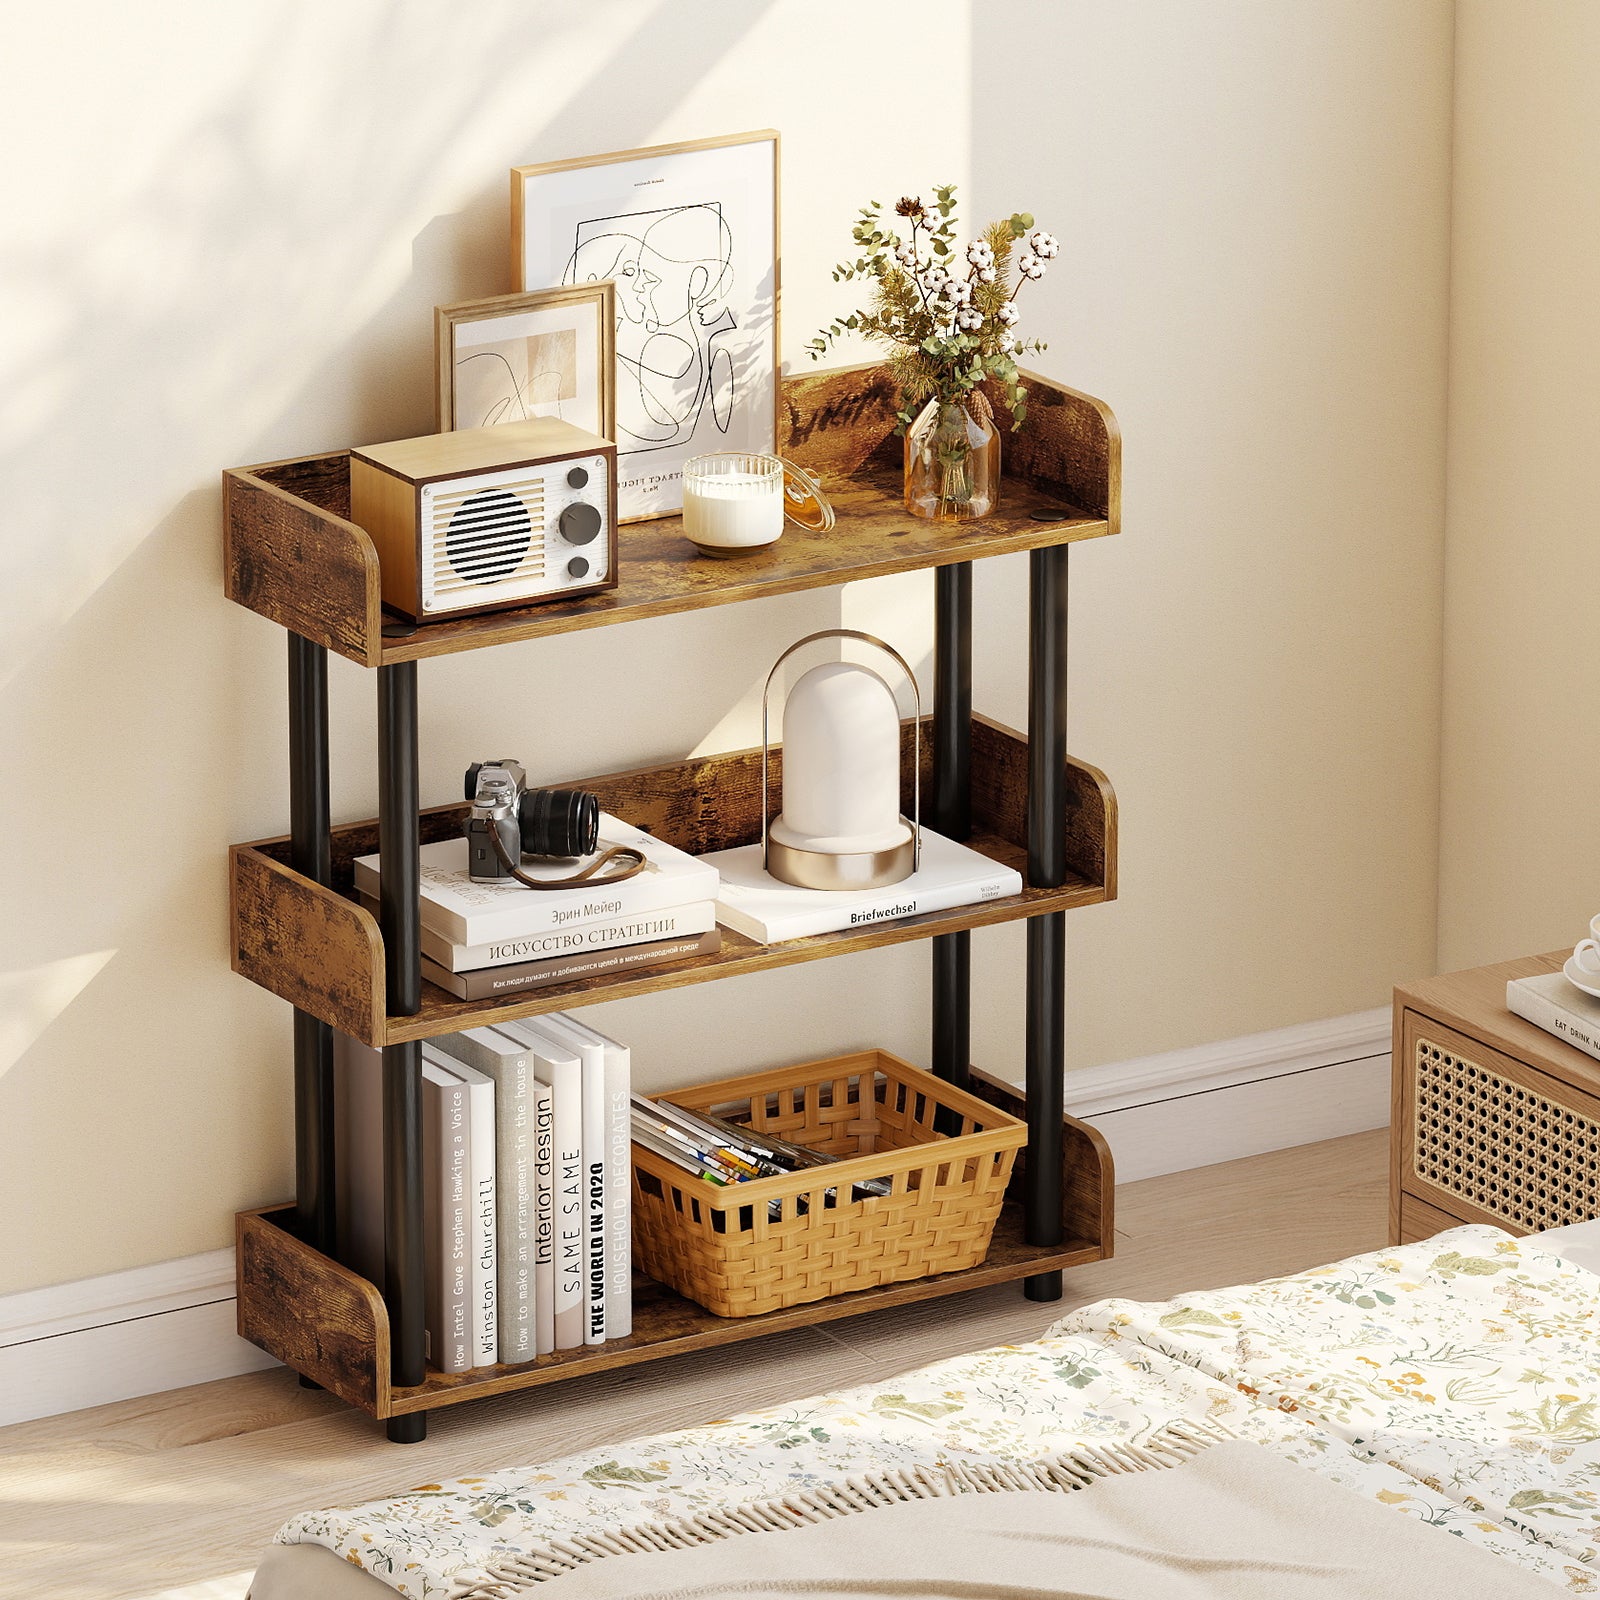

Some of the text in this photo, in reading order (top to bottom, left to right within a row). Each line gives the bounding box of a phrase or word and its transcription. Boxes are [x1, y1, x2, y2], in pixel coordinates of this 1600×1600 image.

[489, 919, 676, 960] ИСКУССТВО СТРАТЕГИИ
[493, 980, 506, 989] Как
[506, 978, 524, 986] люди
[524, 972, 550, 983] думают
[557, 963, 597, 976] добиваются
[598, 957, 619, 968] целей
[624, 946, 678, 963] международной
[679, 943, 699, 953] среде
[551, 900, 622, 925] Эрин Мейер
[850, 901, 917, 924] Briefwechsel
[1555, 1019, 1567, 1031] EAT
[1570, 1027, 1590, 1044] DRINK
[451, 1092, 466, 1367] How Intel Gave Stephen Hawking a Voice
[514, 1059, 530, 1351] How to make an arrangement in the house
[534, 1098, 553, 1265] Interior design
[563, 1149, 580, 1293] SAME SAME
[590, 1162, 604, 1338] THE WORLD IN 2020
[612, 1090, 627, 1295] HOUSEHOLD DECORATES
[479, 1176, 494, 1354] Winston Churchill
